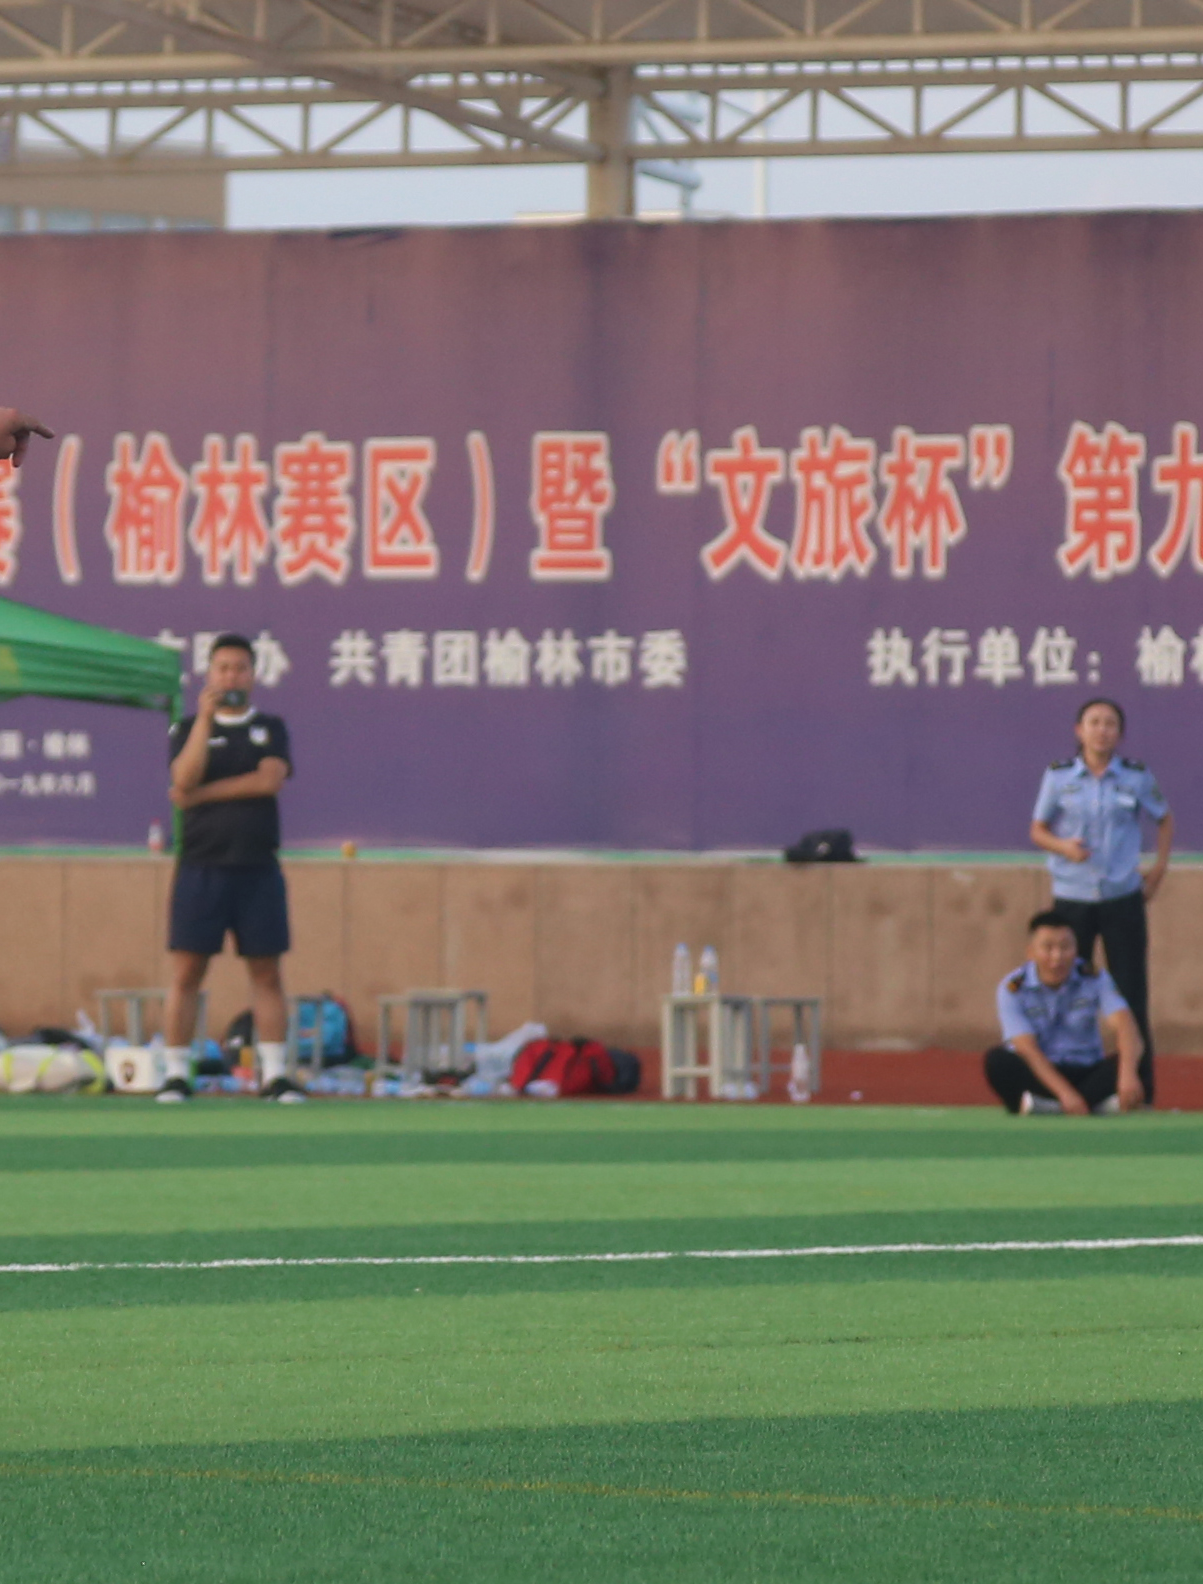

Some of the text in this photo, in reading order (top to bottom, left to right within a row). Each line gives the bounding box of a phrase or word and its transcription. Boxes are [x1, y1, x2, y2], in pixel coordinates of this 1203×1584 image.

[328, 628, 688, 688] 共青团榆林市委
